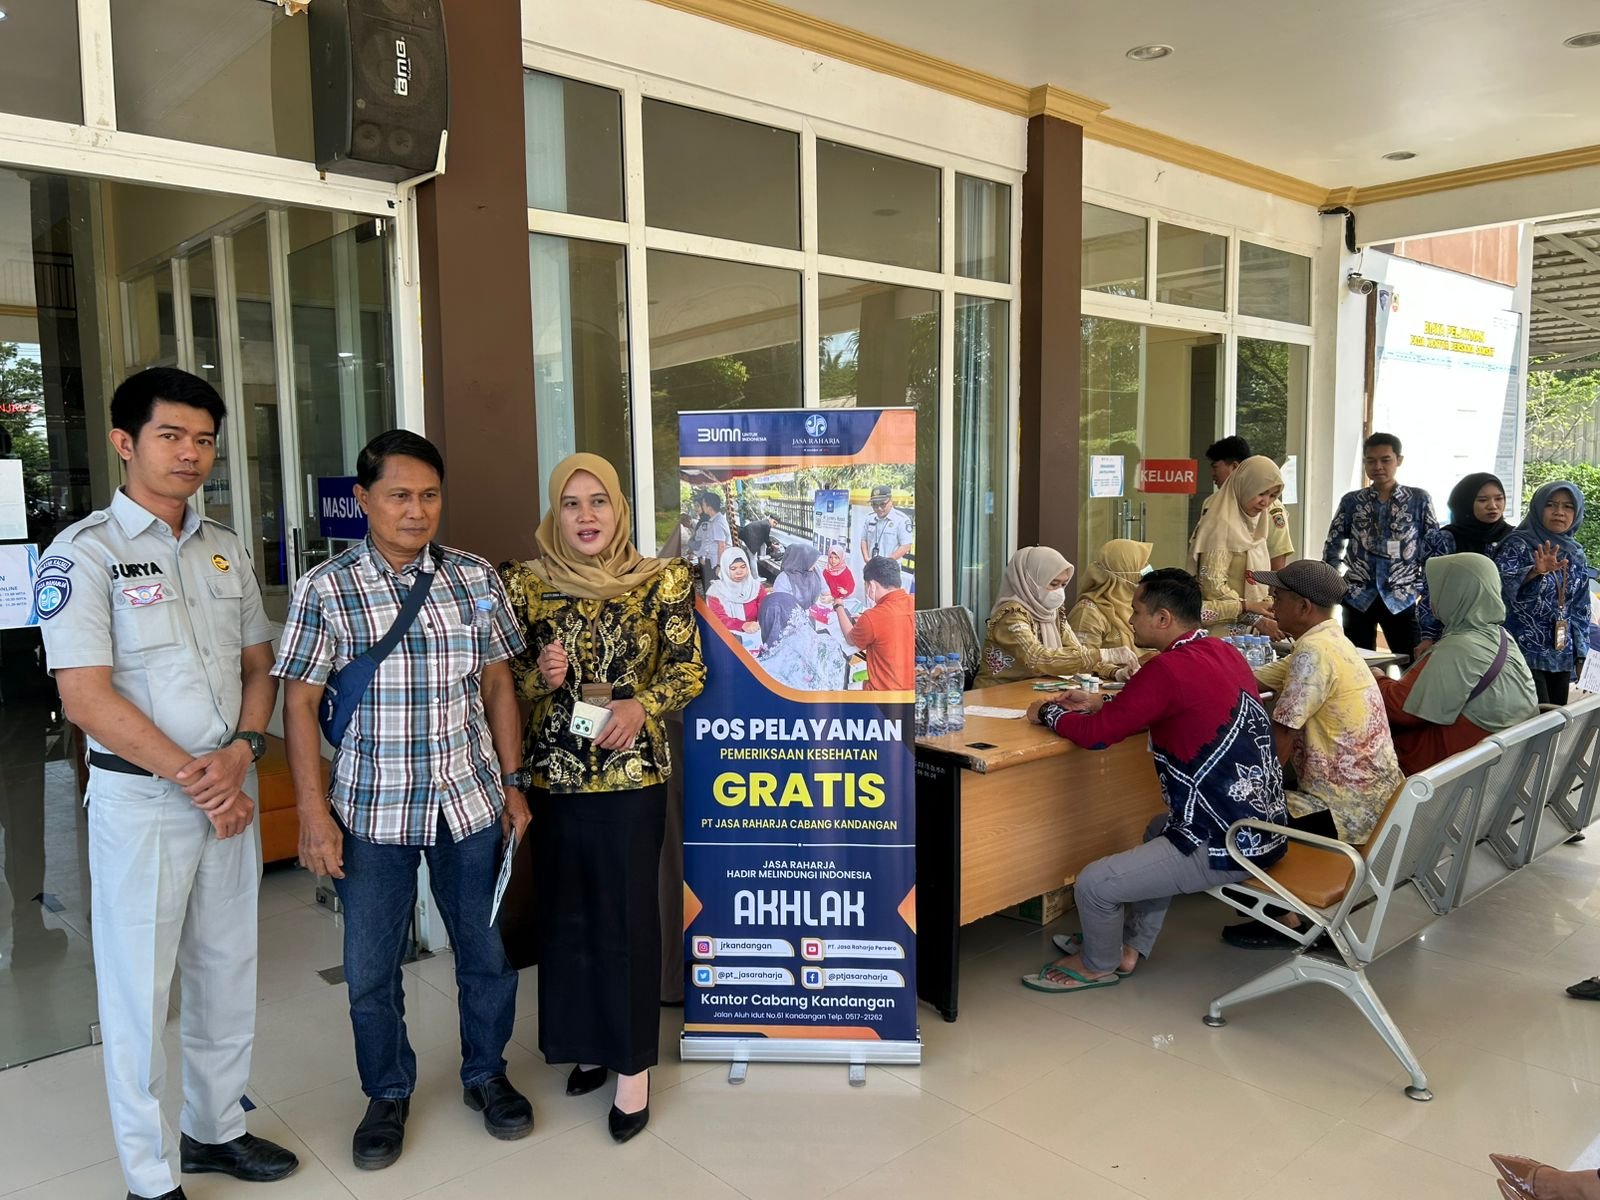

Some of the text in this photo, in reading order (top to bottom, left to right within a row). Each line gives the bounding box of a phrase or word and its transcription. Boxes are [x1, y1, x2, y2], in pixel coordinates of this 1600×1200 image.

[1140, 470, 1194, 483] KELUAR
[322, 496, 363, 519] MASUK
[111, 561, 163, 580] SURYA
[696, 718, 903, 742] POS PELAYANAN
[720, 748, 878, 760] PEMERIKSAAN KESEHATAN
[712, 771, 886, 808] GRATIS
[701, 818, 897, 830] PT JASA RAHARJA CABANG KANDANGAN
[763, 860, 836, 870] JASA RAHARJA
[727, 870, 872, 880] HADIR MELINDUNGI INDONESIA
[734, 889, 865, 927] AKHLAK
[720, 941, 772, 952] jrkandangan
[717, 971, 783, 981] @pt_jasaraharja
[828, 972, 888, 982] @ptjasaraharja
[701, 993, 895, 1011] Kantor Cabang Kandangan
[785, 1013, 827, 1021] Kandangan
[828, 1013, 845, 1021] Telp.
[845, 1013, 883, 1021] 0517-21262
